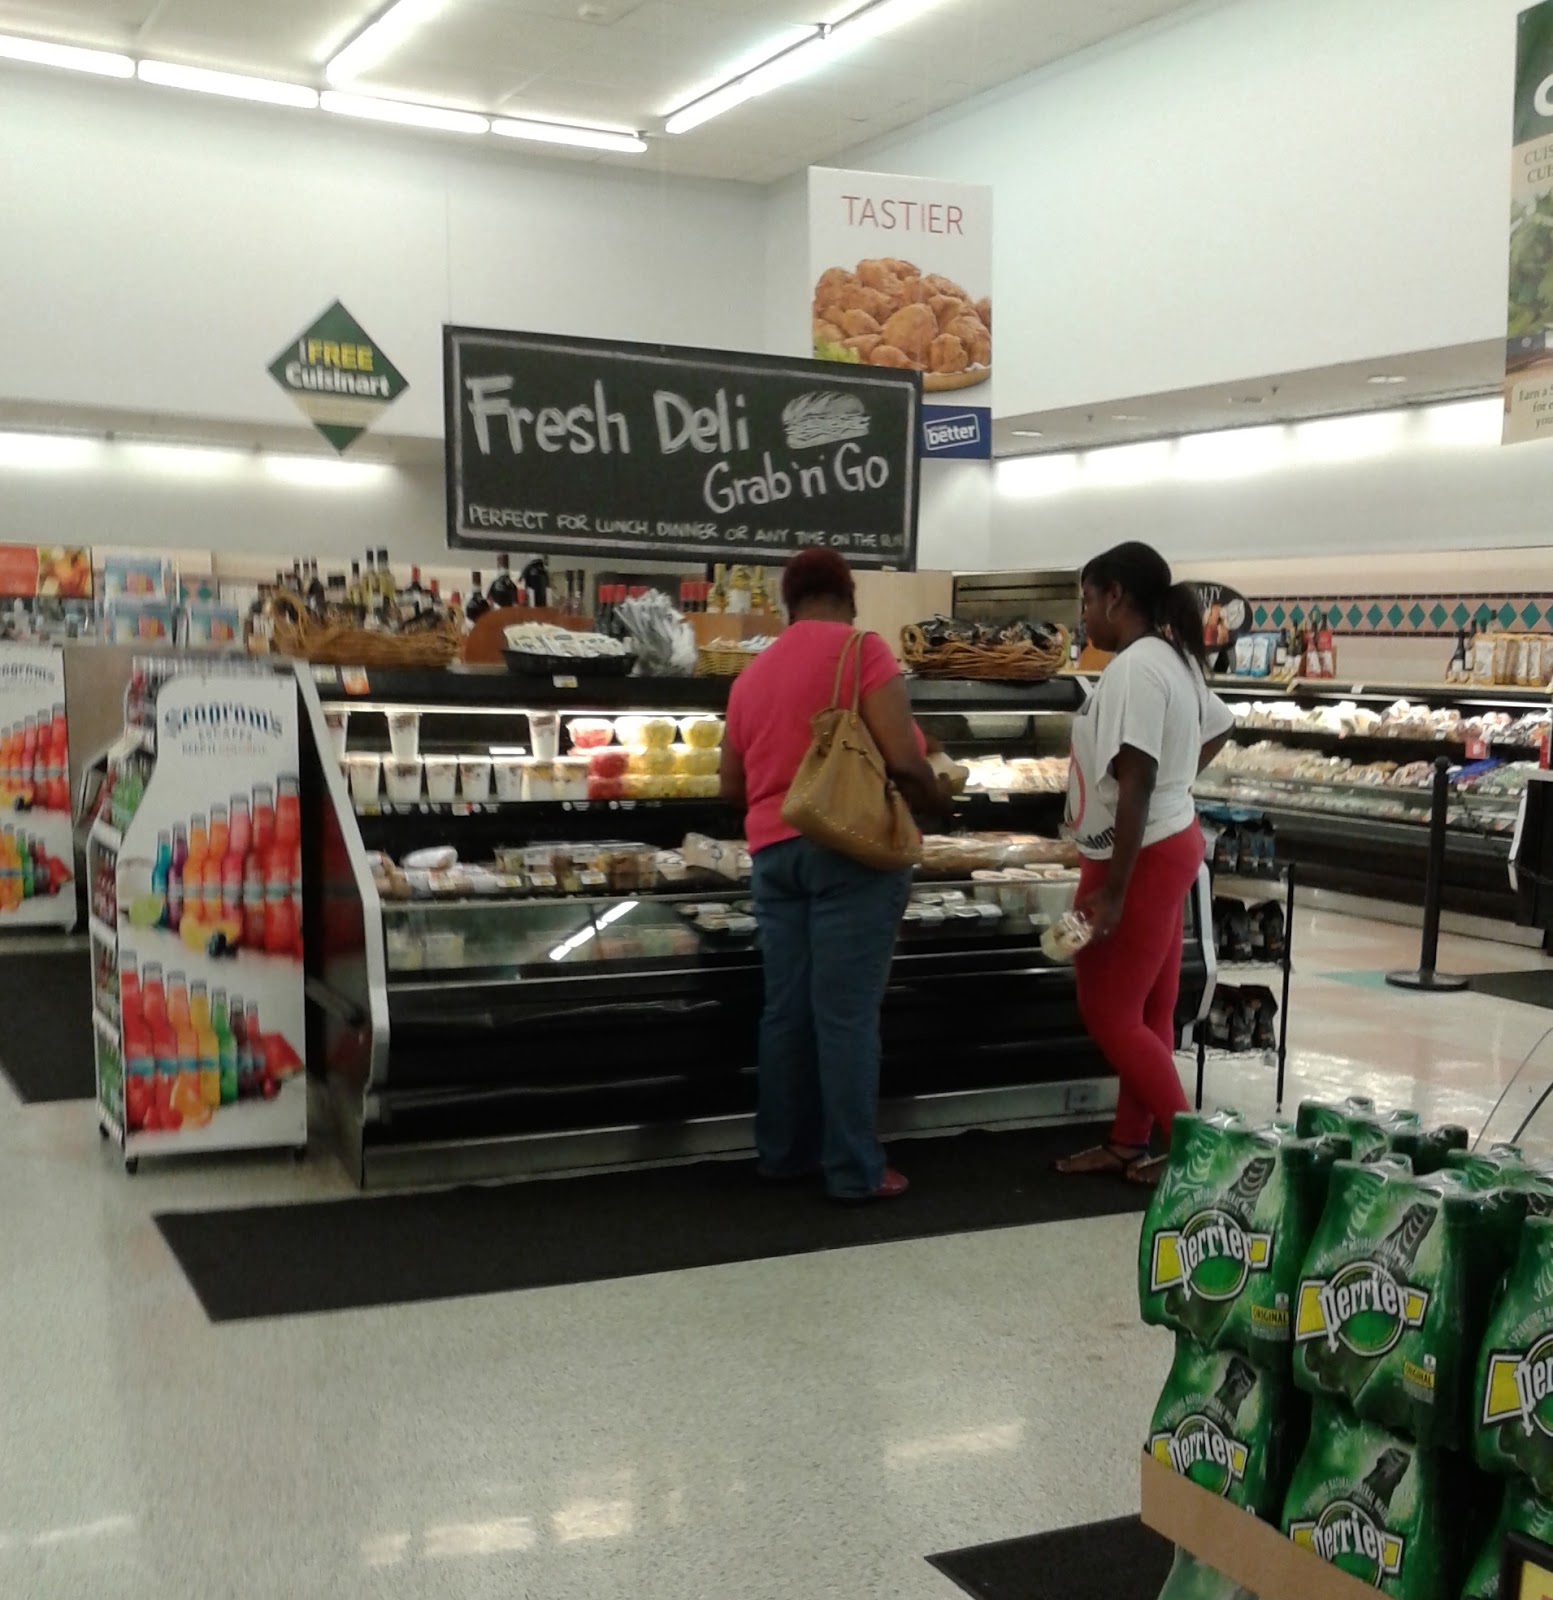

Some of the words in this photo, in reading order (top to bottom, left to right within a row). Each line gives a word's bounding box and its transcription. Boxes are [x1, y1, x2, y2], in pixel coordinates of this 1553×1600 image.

[841, 195, 963, 235] TASTIER
[308, 338, 374, 372] FREE
[465, 375, 631, 455] Fresh
[653, 388, 750, 455] Deli
[927, 425, 976, 445] better
[703, 451, 792, 515] Grab
[833, 442, 890, 492] Go
[468, 503, 549, 531] PERFECT
[556, 513, 591, 532] FOR
[656, 521, 719, 541] DINNER
[723, 524, 749, 542] OR
[753, 528, 790, 544] ANY
[793, 530, 827, 547] TIME
[829, 533, 850, 548] ON
[851, 532, 877, 548] THE
